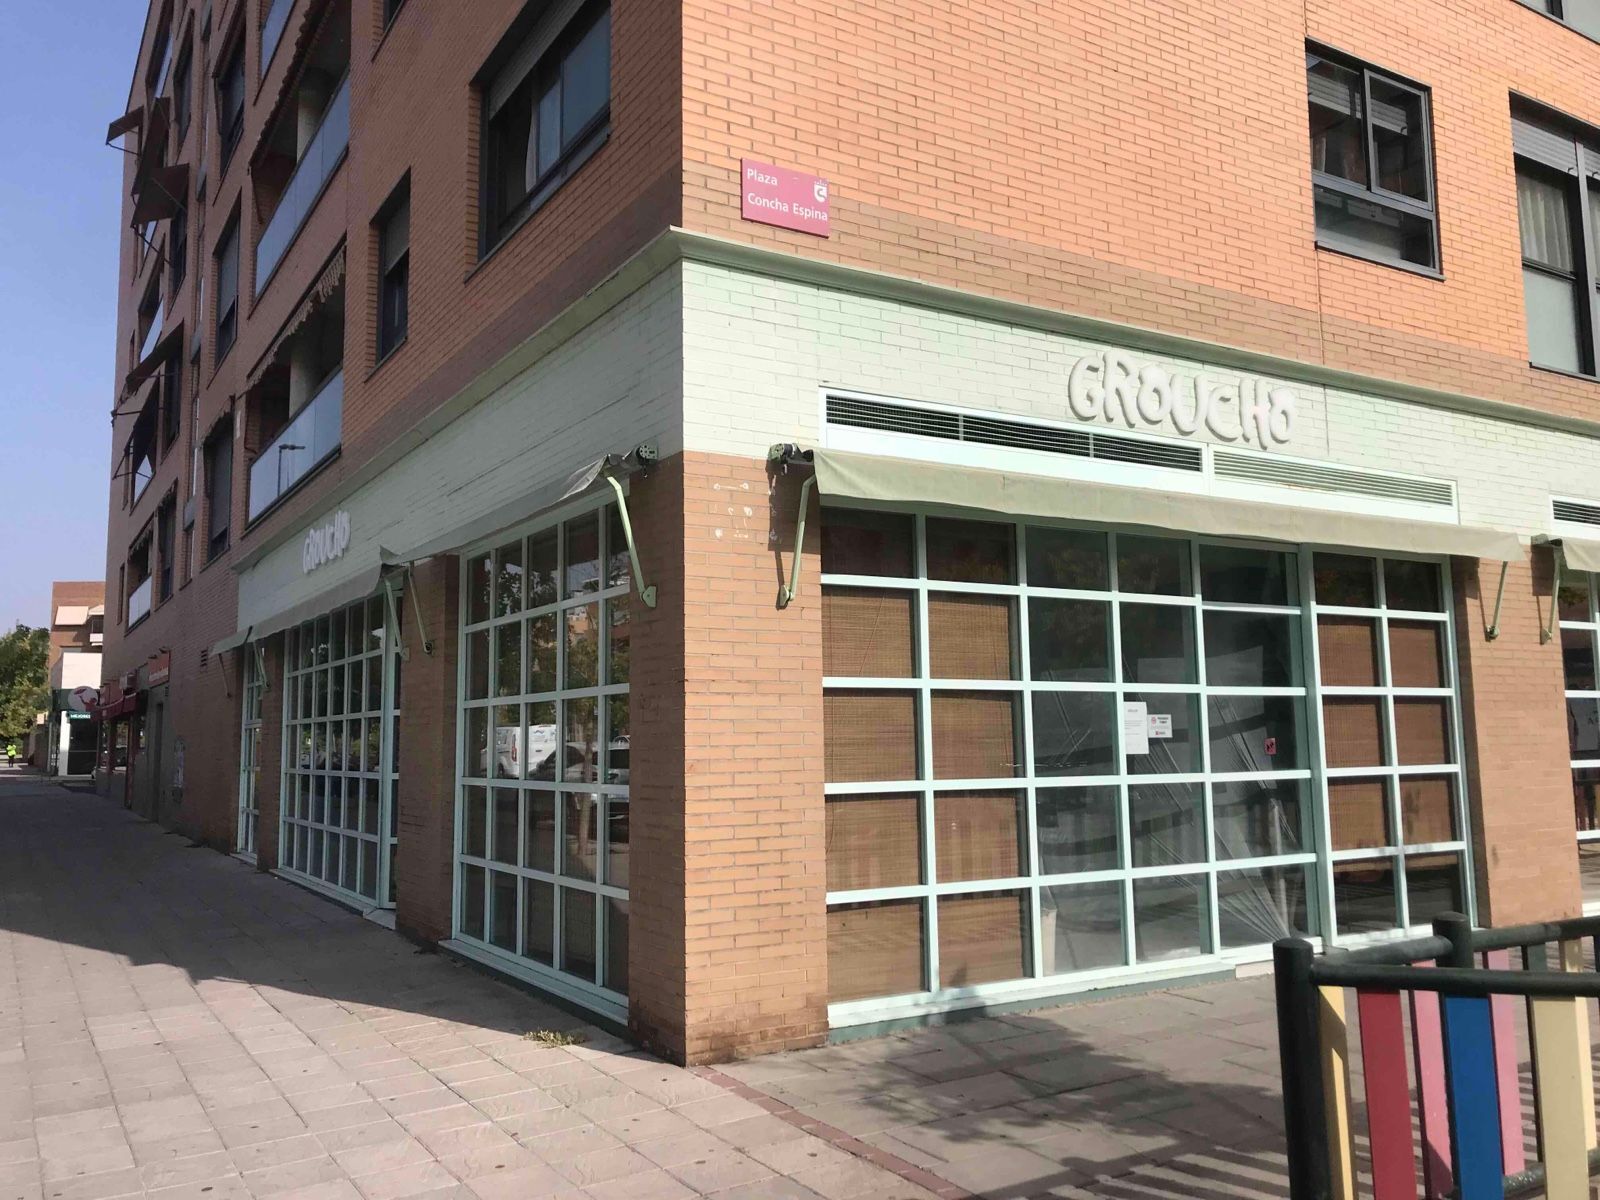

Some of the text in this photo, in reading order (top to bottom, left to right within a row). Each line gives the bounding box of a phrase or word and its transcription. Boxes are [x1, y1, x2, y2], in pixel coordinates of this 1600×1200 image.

[747, 168, 778, 186] Plaza
[747, 192, 828, 221] Concha Espina
[1068, 351, 1297, 450] GROUCHO
